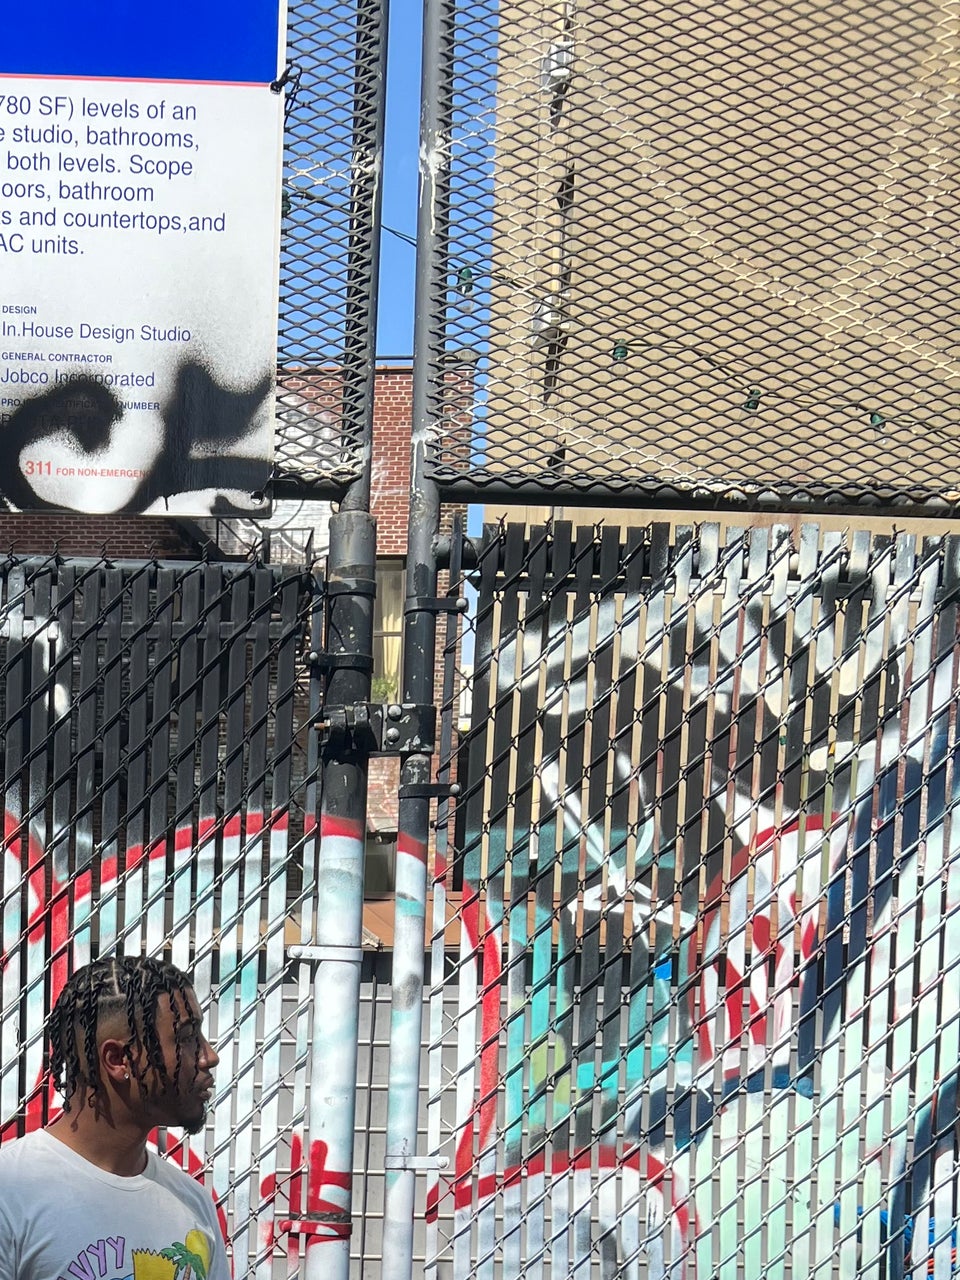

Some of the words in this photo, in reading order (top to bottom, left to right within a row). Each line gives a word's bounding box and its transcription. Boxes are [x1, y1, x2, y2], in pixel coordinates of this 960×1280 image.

[39, 96, 73, 121] SF)
[83, 97, 139, 118] levels
[147, 100, 165, 119] of
[173, 105, 196, 120] an
[13, 124, 78, 147] studio,
[87, 125, 198, 151] bathrooms,
[8, 151, 50, 171] both
[59, 152, 120, 173] levels.
[130, 154, 192, 180] Scope
[59, 180, 153, 201] bathroom
[20, 207, 56, 226] and
[64, 211, 225, 234] countertops,and
[32, 235, 83, 254] units.
[2, 306, 36, 314] DESIGN
[3, 321, 73, 338] In.House
[80, 324, 134, 343] Design
[141, 325, 190, 341] Studio
[1, 352, 45, 361] GENERAL
[48, 353, 113, 363] CONTRACTOR
[1, 367, 49, 384] Jobco
[25, 461, 52, 476] 311
[56, 468, 75, 476] FOR
